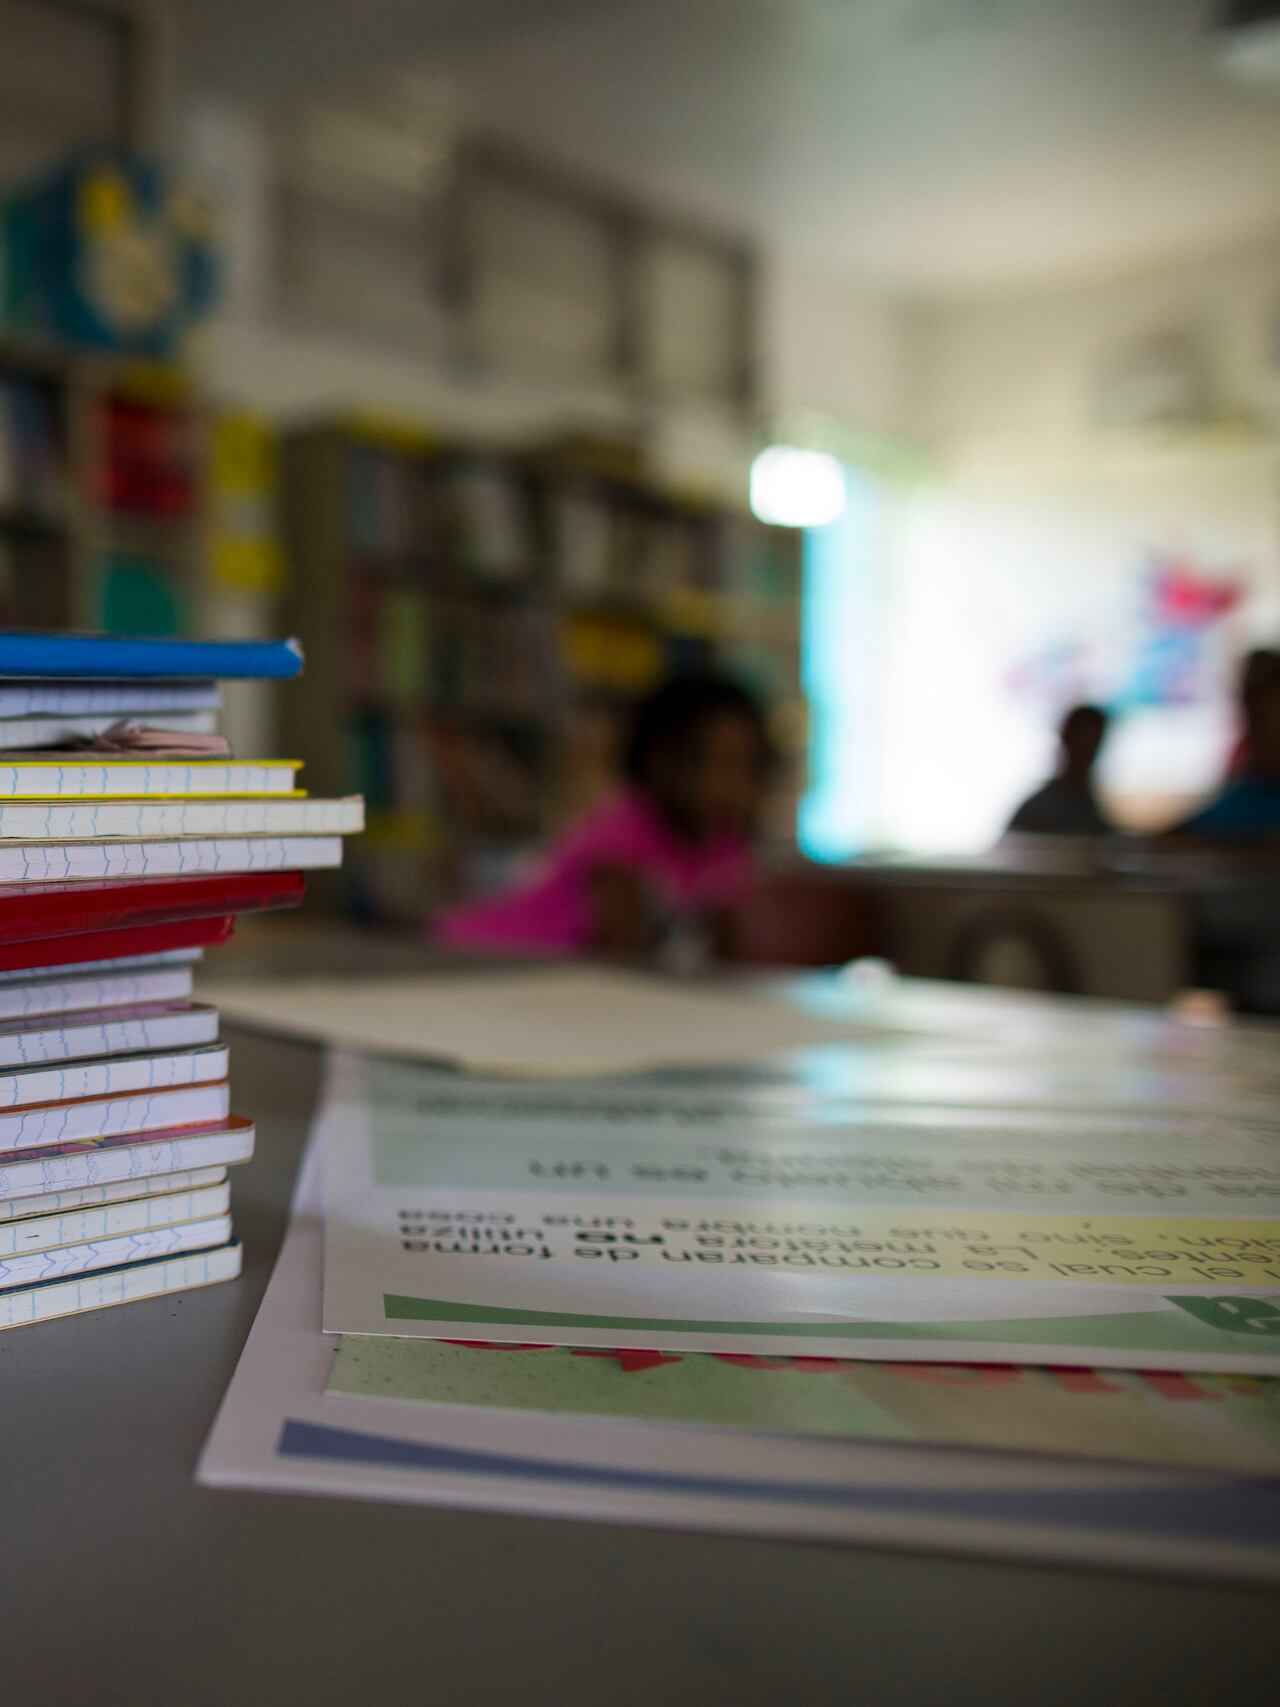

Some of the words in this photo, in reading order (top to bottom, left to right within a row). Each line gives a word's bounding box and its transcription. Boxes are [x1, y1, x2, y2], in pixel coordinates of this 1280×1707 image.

[527, 1160, 611, 1181] un
[1095, 1181, 1188, 1200] de
[397, 1210, 516, 1225] cosa
[541, 1214, 634, 1229] una
[400, 1224, 544, 1243] utiliza
[661, 1219, 861, 1238] nombra
[888, 1225, 990, 1242] que
[574, 1231, 664, 1245] no
[696, 1235, 937, 1254] metáfora
[1018, 1231, 1134, 1247] sino
[402, 1240, 553, 1260] forma
[574, 1248, 640, 1262] de
[965, 1245, 1038, 1260] La
[1094, 1249, 1280, 1264] entes.
[661, 1250, 941, 1271] comparan
[961, 1260, 1029, 1273] se
[1048, 1262, 1172, 1277] cual
[1191, 1266, 1245, 1280] el
